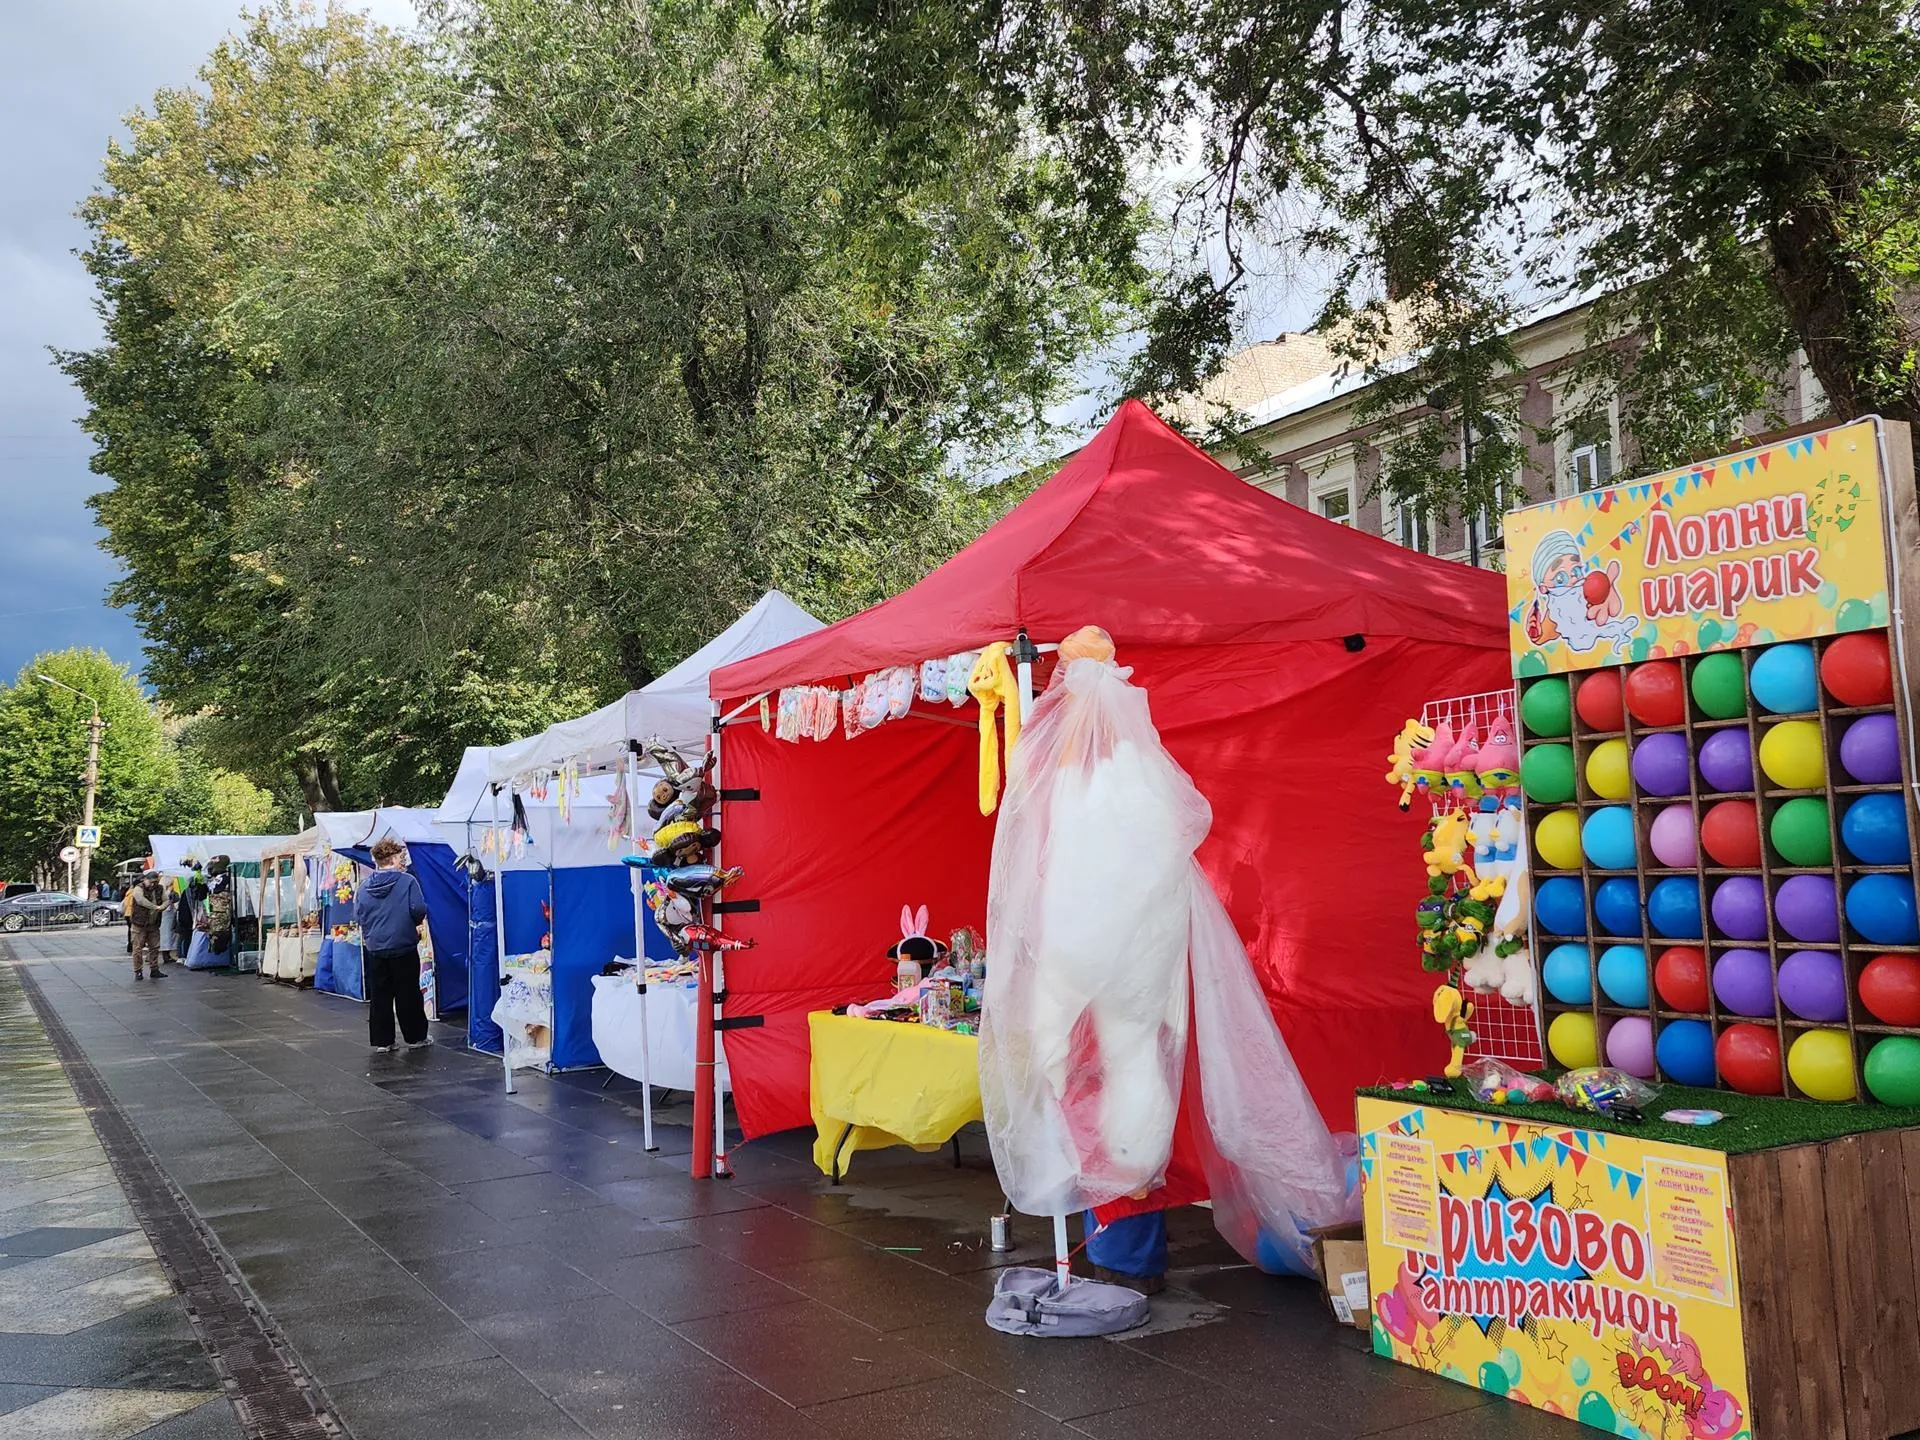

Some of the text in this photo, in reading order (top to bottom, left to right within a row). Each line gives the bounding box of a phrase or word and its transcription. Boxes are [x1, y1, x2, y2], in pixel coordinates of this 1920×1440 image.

[1645, 496, 1808, 567] Лопни
[1642, 548, 1823, 617] шарик
[1405, 1196, 1651, 1281] ризово
[1423, 1277, 1679, 1346] аттракцион
[1615, 1351, 1707, 1420] BOOM!
